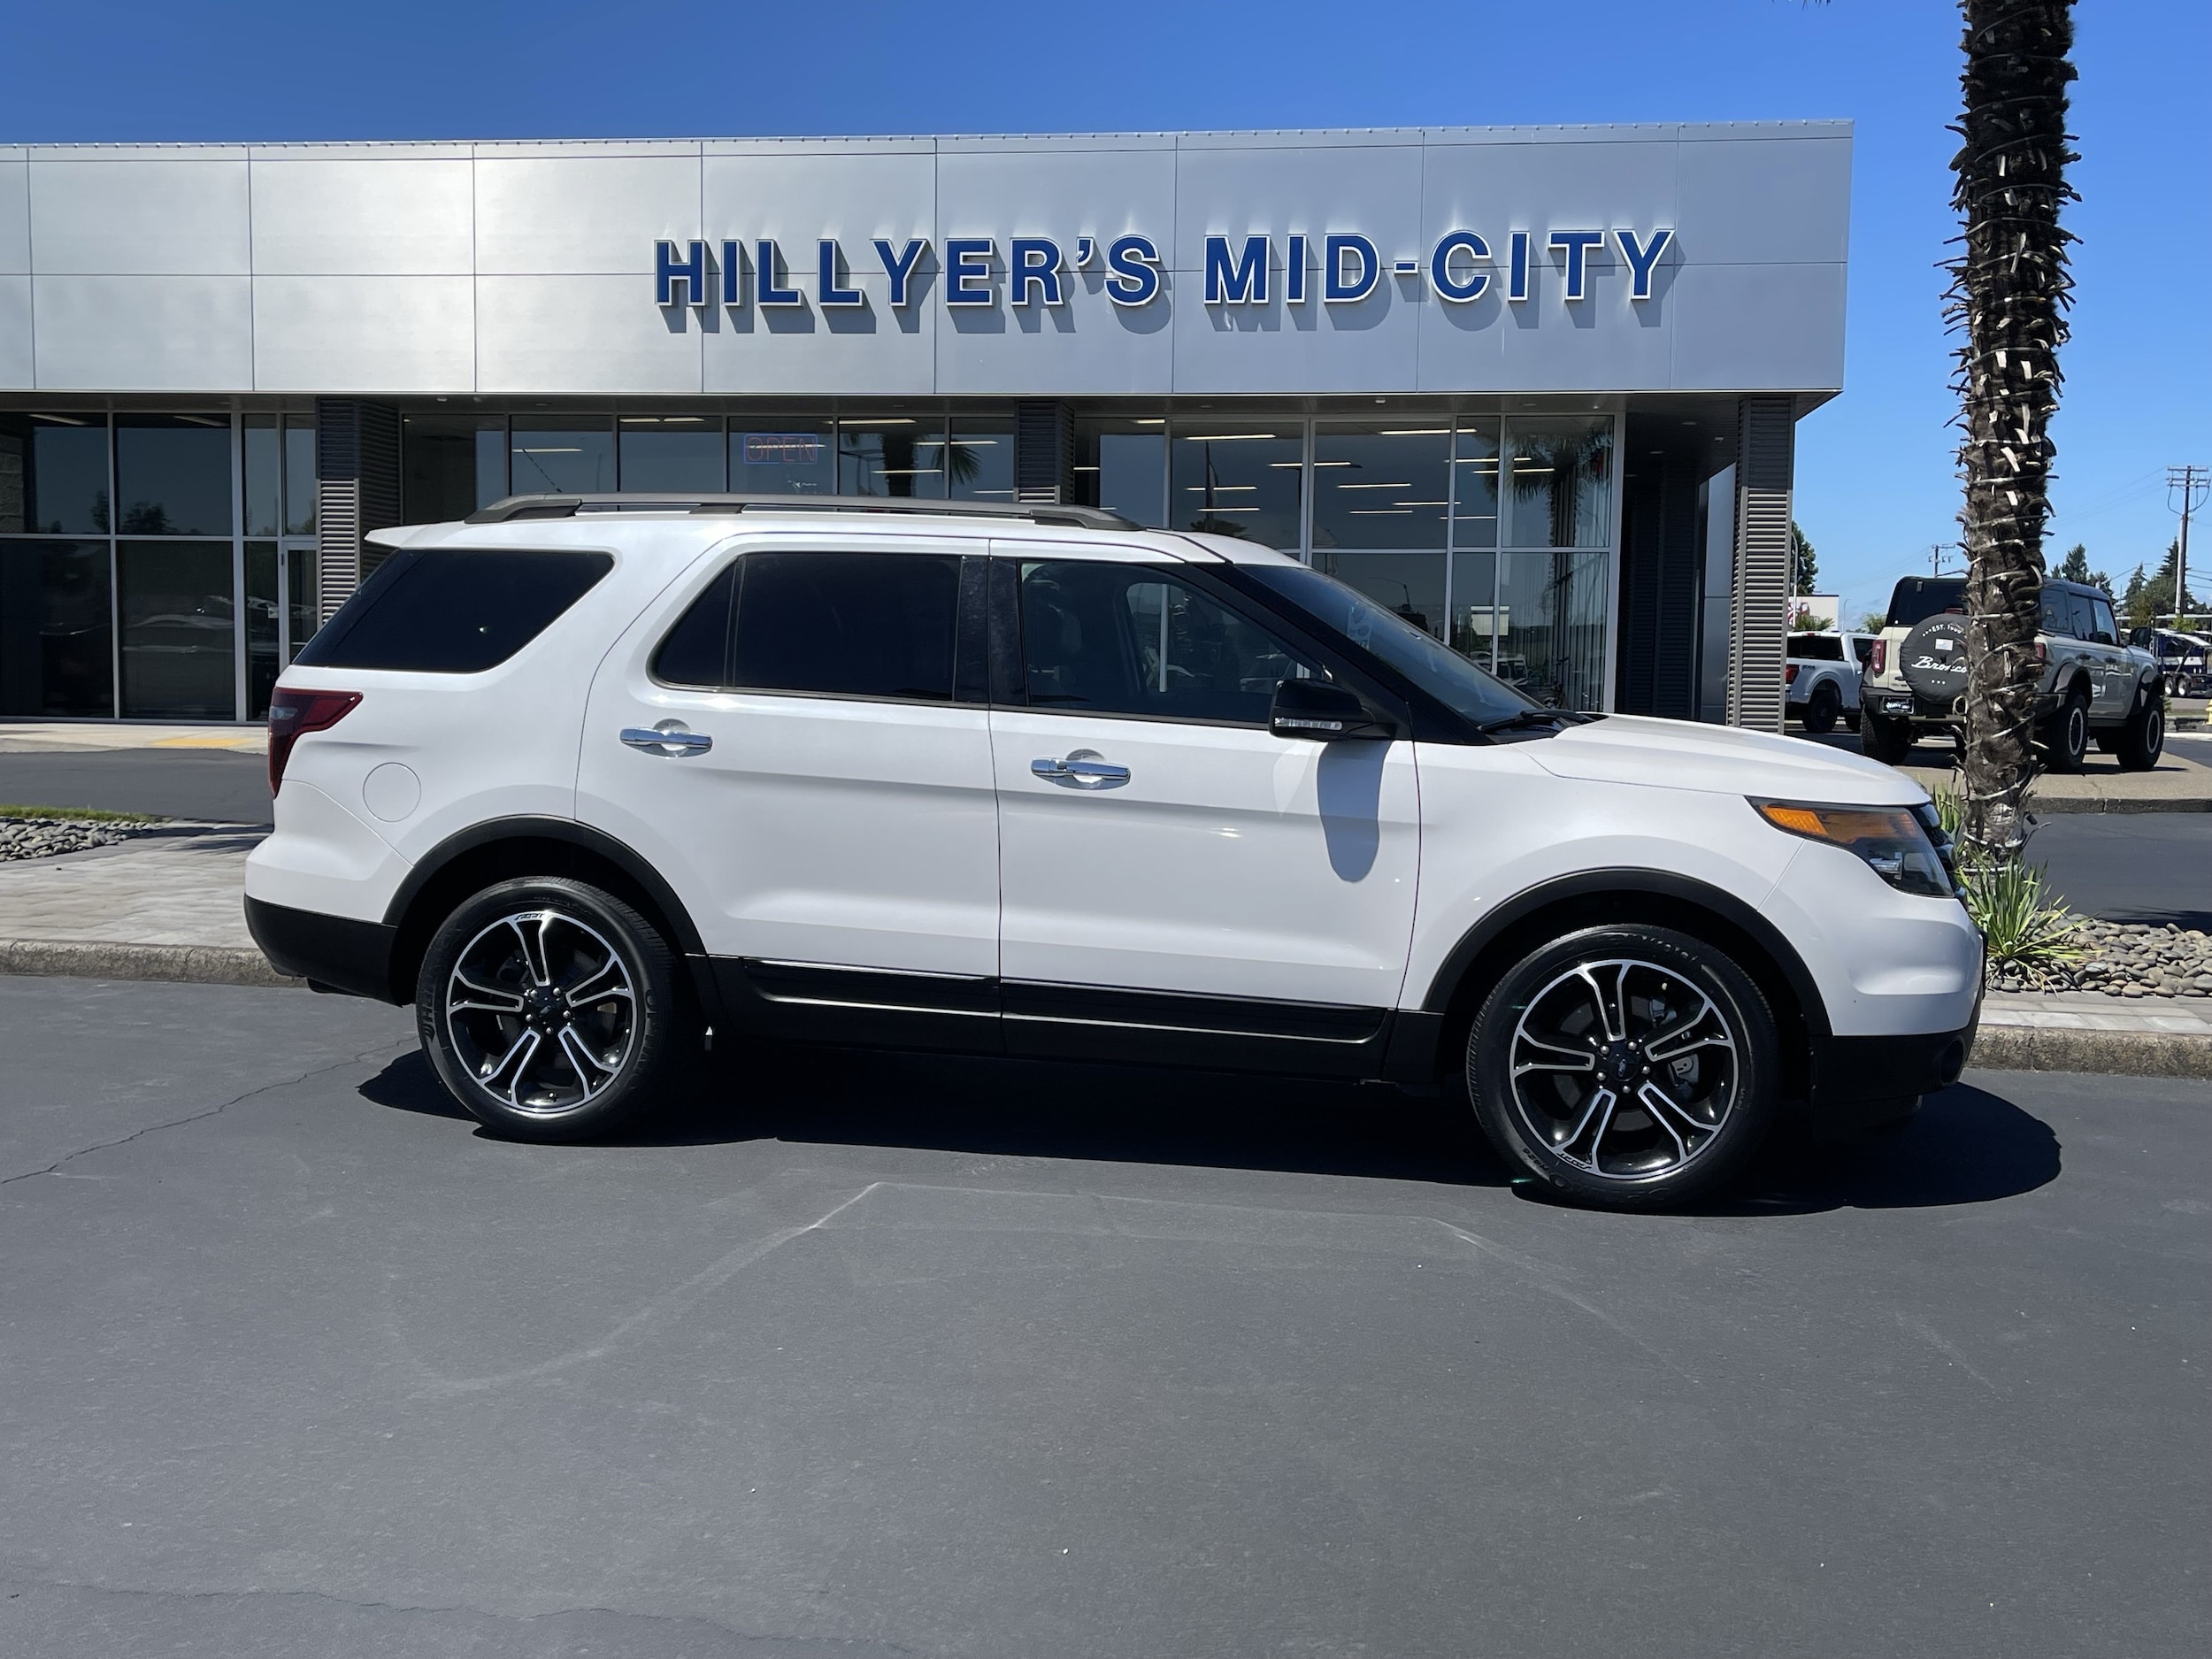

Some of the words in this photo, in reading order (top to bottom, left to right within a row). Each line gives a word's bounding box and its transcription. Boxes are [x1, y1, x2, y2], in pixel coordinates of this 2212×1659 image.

[654, 234, 1160, 308] HILLYER'S
[1203, 228, 1676, 304] MID-CITY
[746, 436, 816, 463] OPEN
